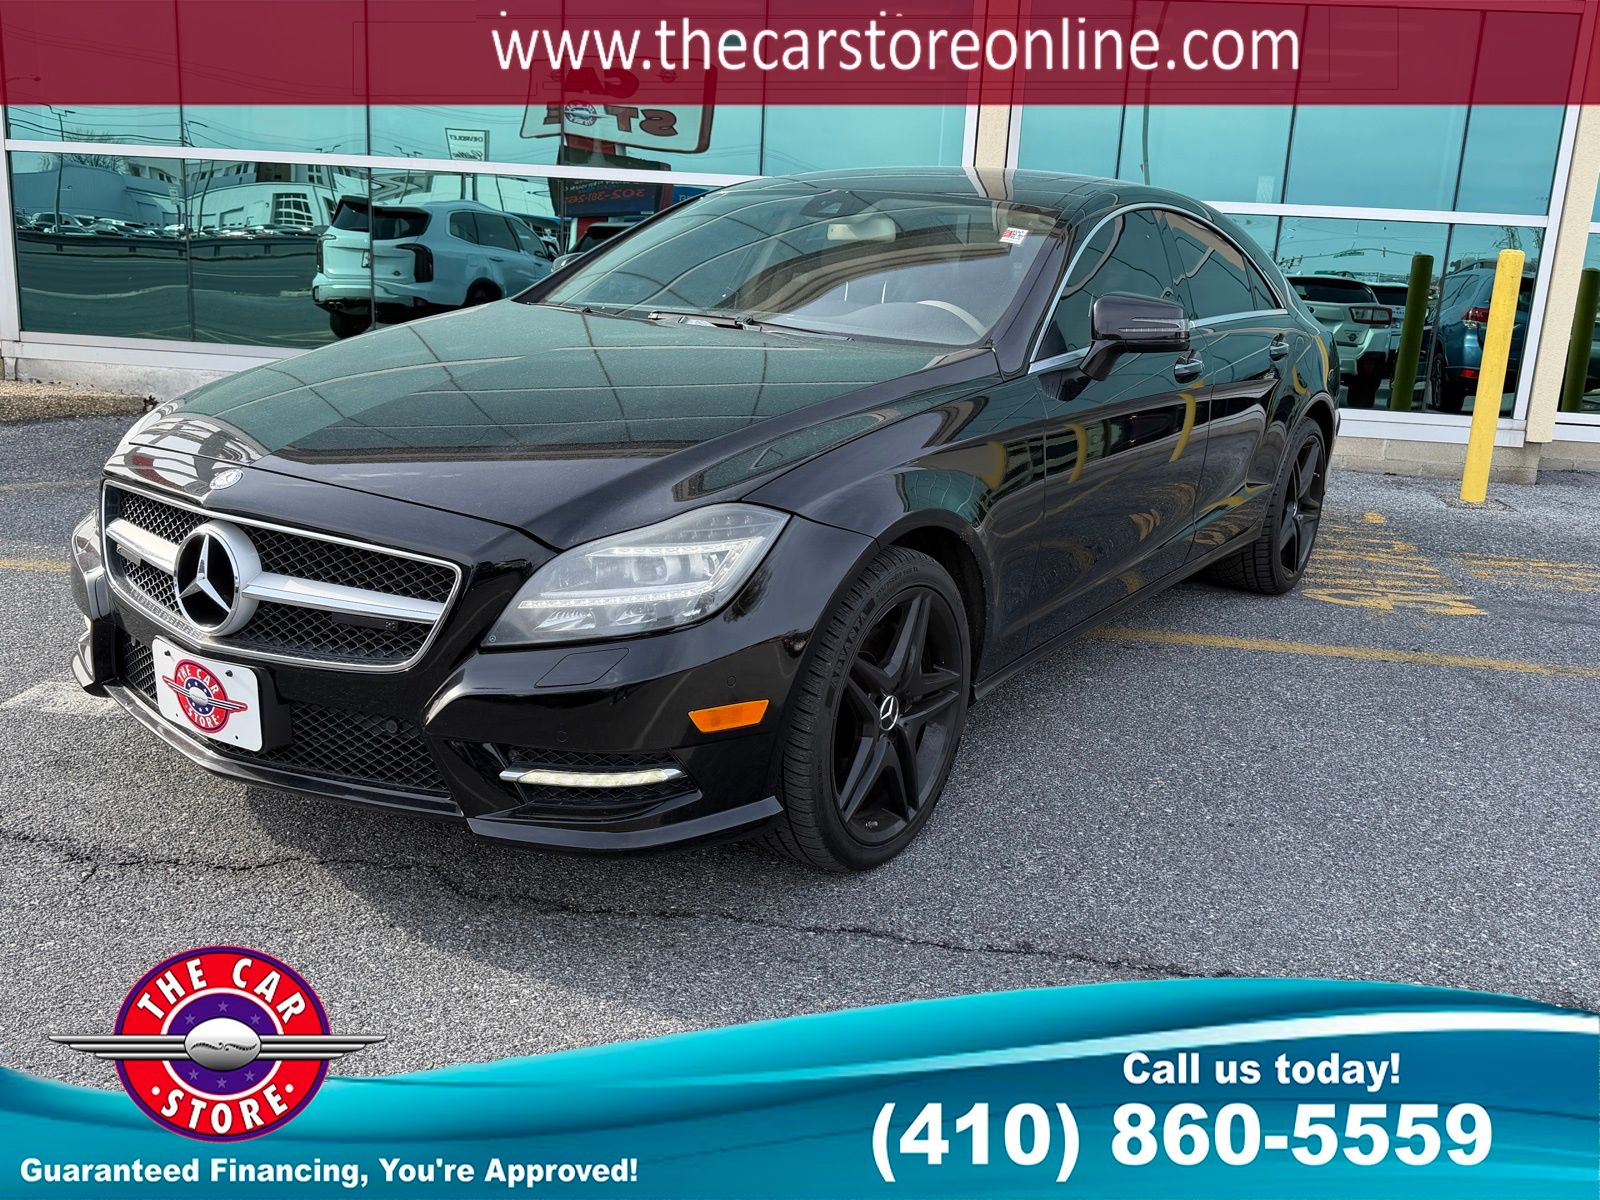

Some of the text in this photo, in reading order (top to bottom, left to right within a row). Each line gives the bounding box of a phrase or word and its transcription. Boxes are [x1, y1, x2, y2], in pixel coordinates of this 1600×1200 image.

[178, 664, 219, 694] THE CAR
[187, 708, 219, 728] STORE
